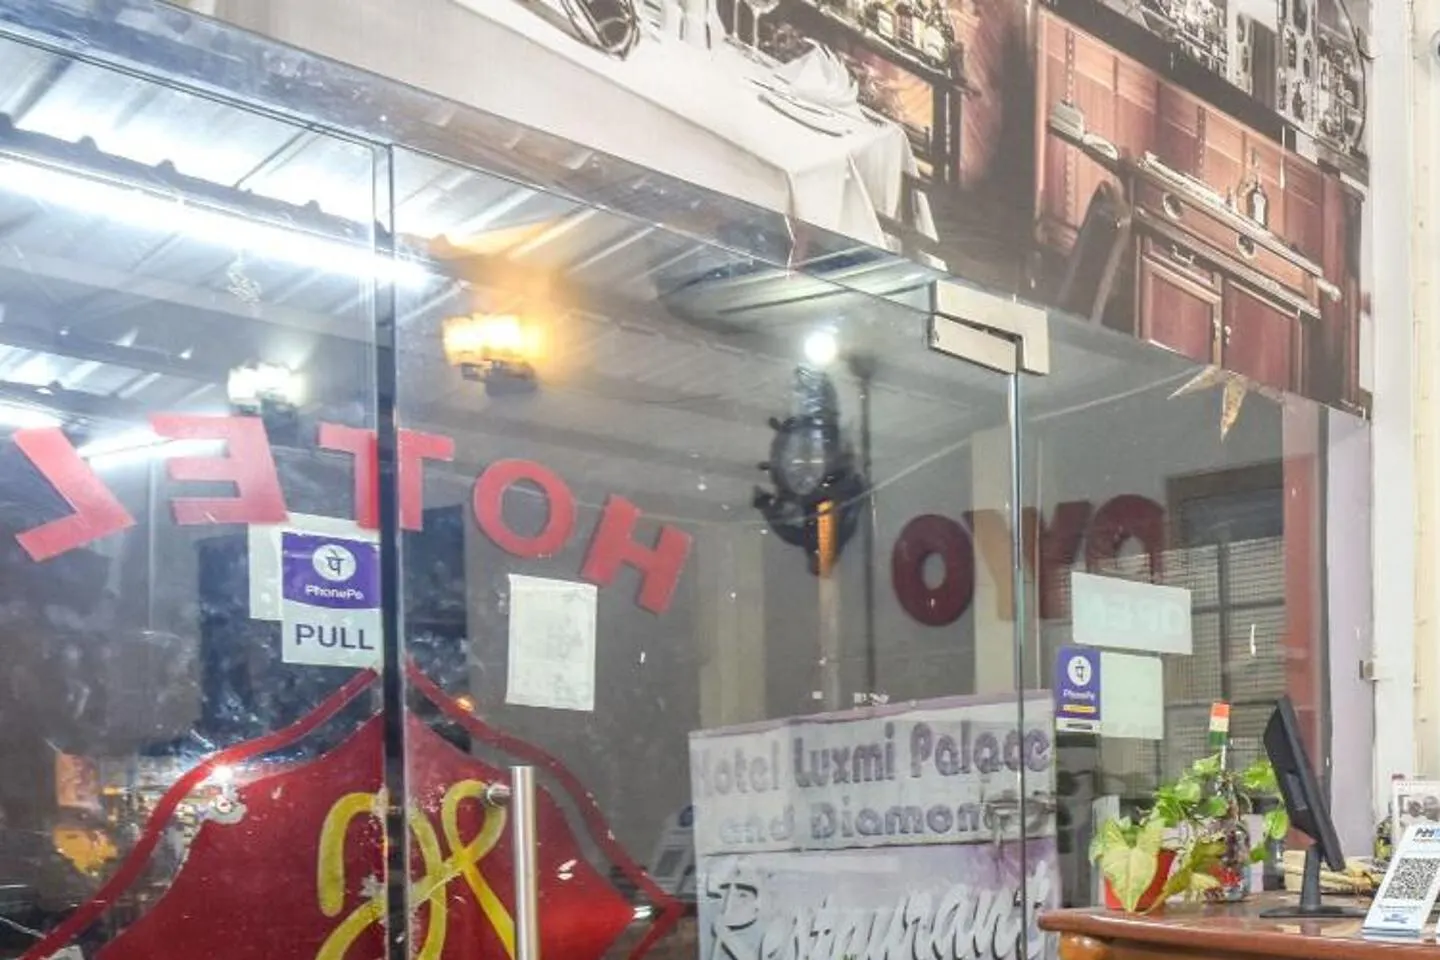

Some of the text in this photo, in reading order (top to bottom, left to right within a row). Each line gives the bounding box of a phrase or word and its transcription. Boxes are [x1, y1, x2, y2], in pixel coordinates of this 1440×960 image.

[304, 584, 365, 600] PhonePe
[295, 623, 375, 650] PULL
[793, 721, 896, 789] Luxmi
[910, 719, 1050, 778] Palace
